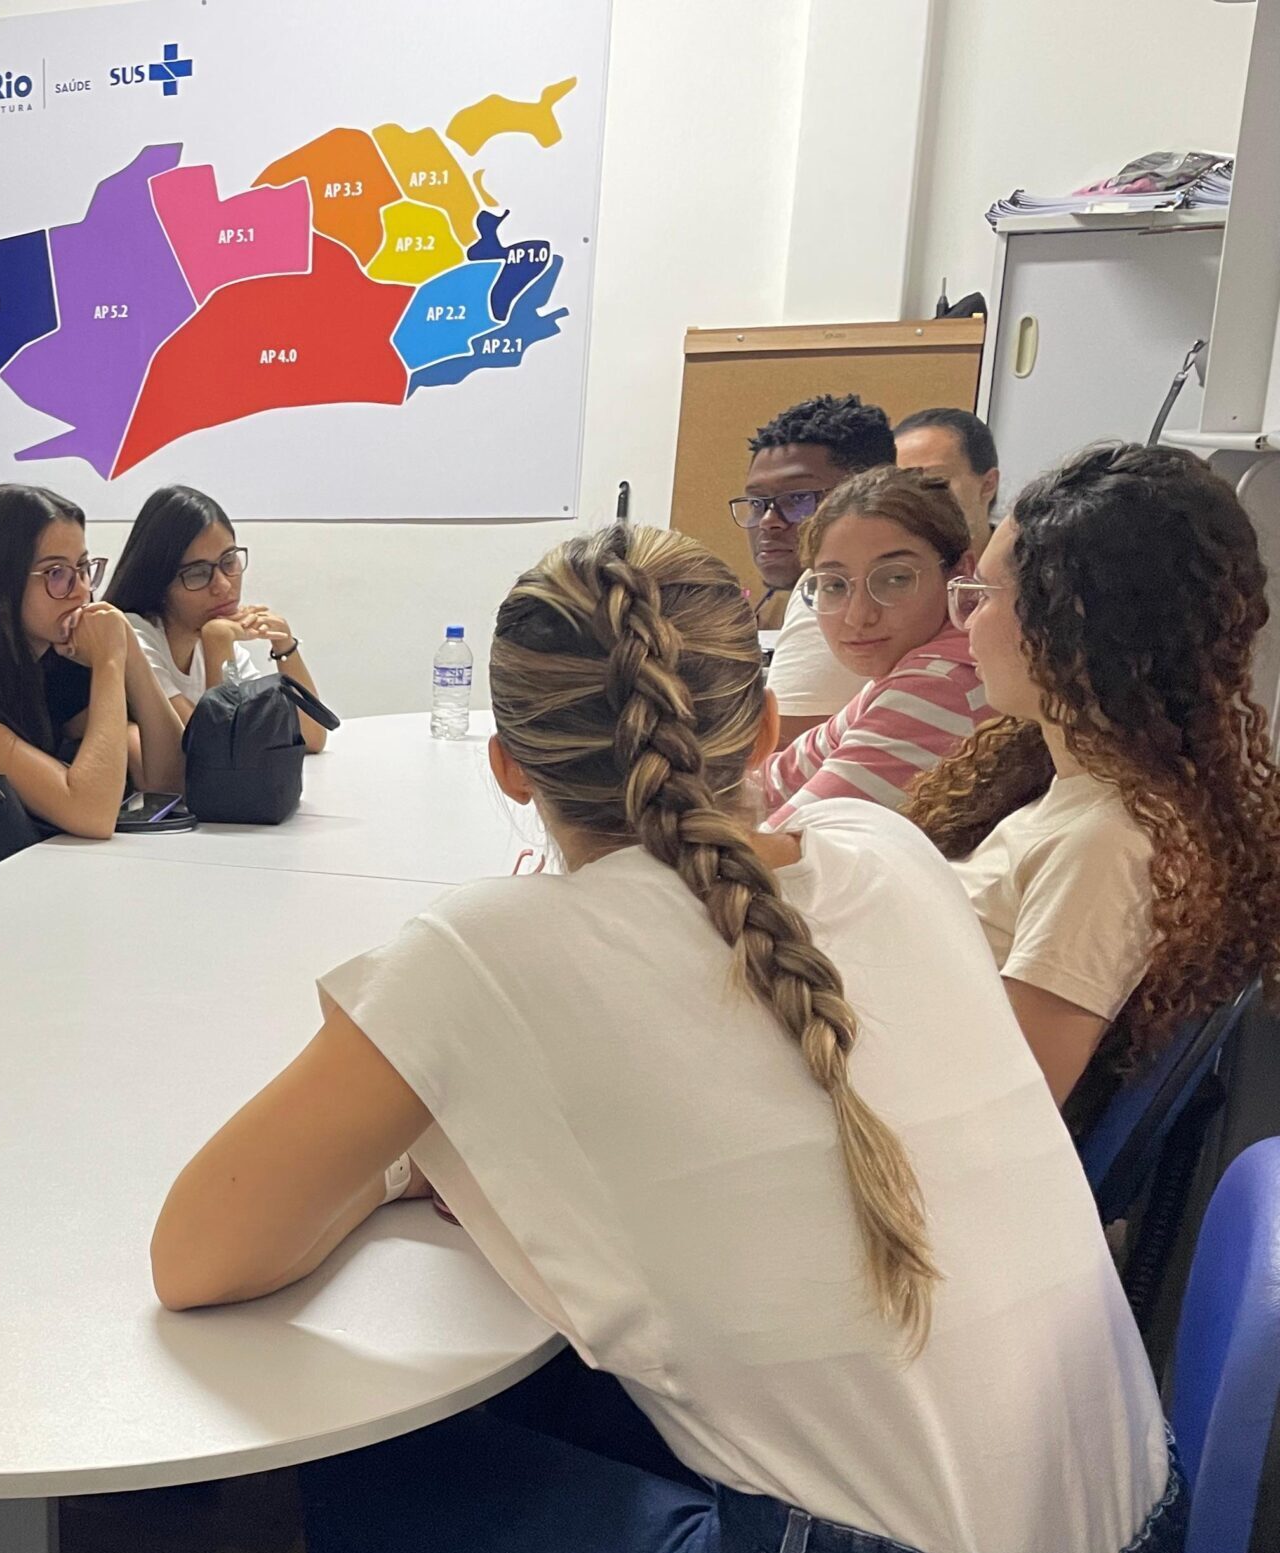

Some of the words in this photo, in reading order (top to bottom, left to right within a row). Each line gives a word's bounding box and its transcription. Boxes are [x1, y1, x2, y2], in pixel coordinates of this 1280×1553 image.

[109, 64, 145, 87] SUS
[55, 78, 91, 94] SAÚDE
[409, 171, 428, 187] AP
[428, 170, 449, 186] 3.1
[324, 182, 342, 198] AP
[343, 181, 363, 197] 3.3
[218, 229, 235, 244] AP
[236, 228, 254, 243] 5.1
[395, 236, 414, 252] AP
[414, 235, 435, 251] 3.2
[506, 248, 526, 265] AP
[527, 247, 548, 263] 1.0
[93, 305, 110, 320] AP
[110, 304, 128, 319] 5.2
[426, 306, 444, 322] AP
[445, 305, 466, 321] 2.2
[482, 338, 501, 354] AP
[501, 338, 522, 353] 2.1
[259, 349, 277, 364] AP
[277, 348, 298, 363] 4.0
